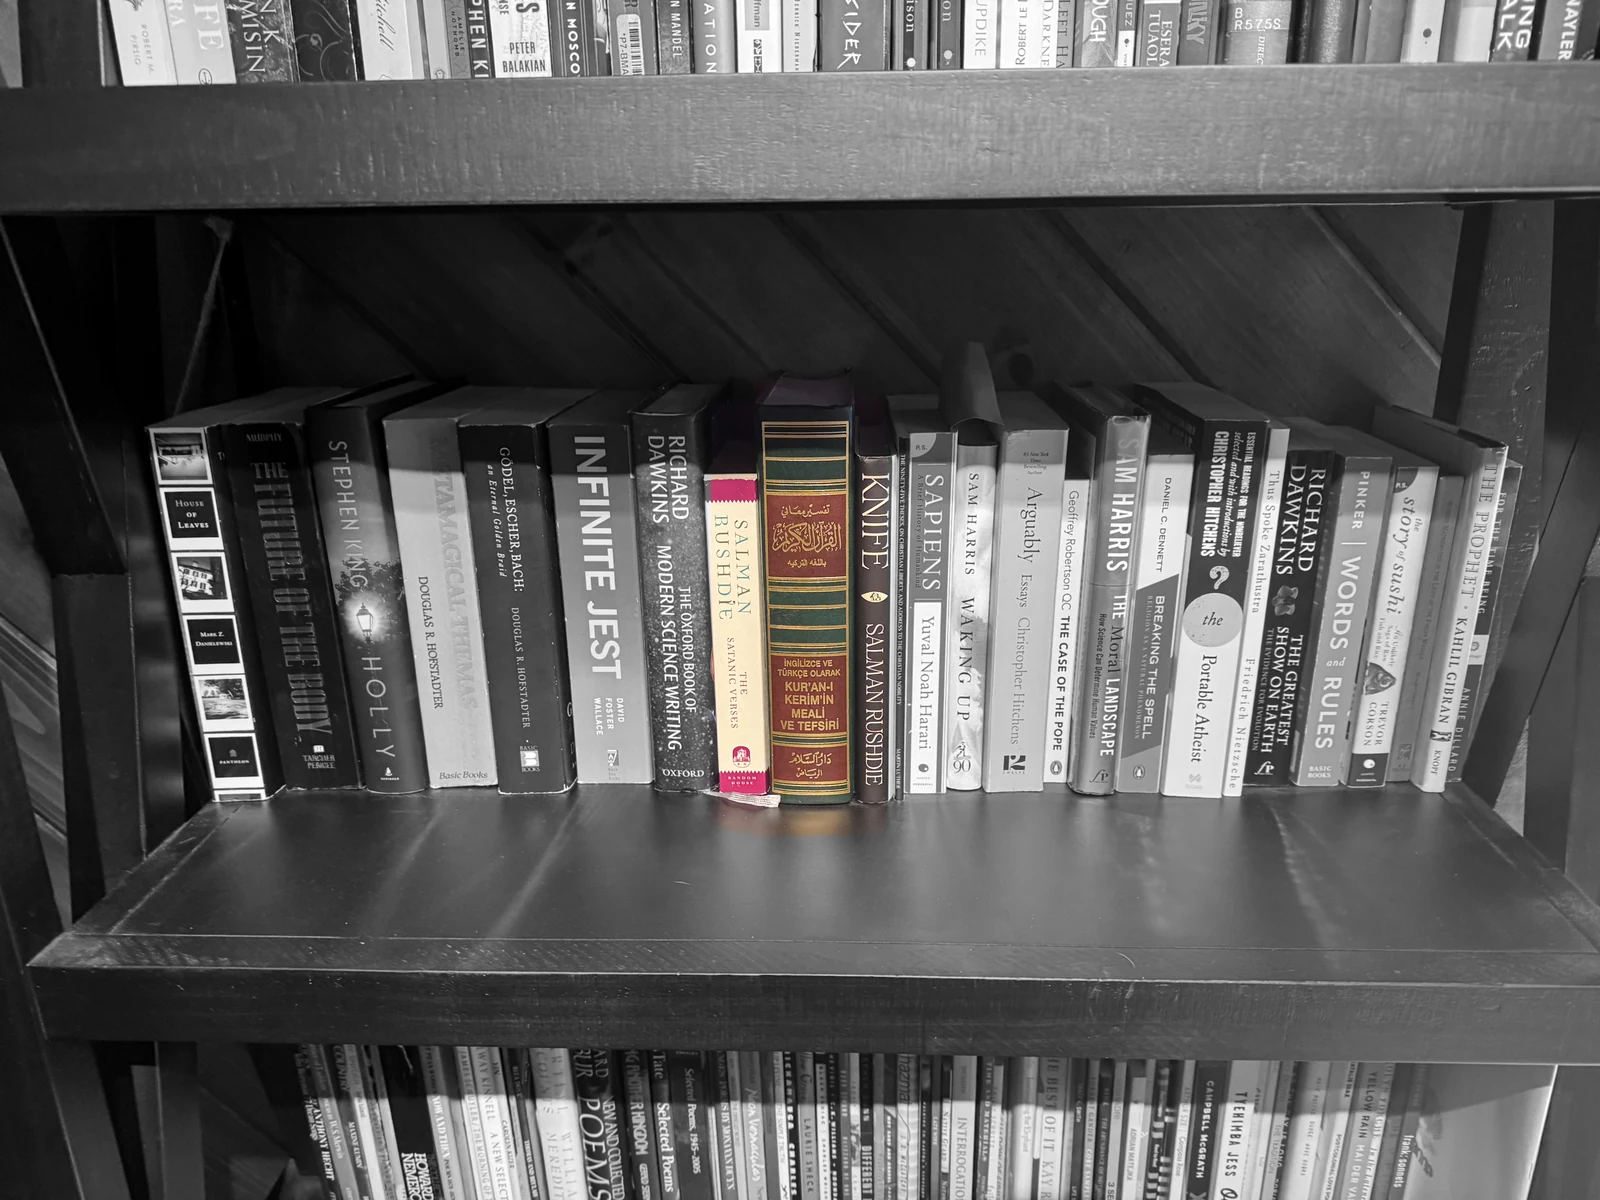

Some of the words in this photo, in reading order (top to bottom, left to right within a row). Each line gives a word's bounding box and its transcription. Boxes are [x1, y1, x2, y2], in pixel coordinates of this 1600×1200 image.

[1234, 7, 1243, 18] B
[509, 42, 536, 54] PETER
[671, 13, 682, 58] MANDEL
[1015, 23, 1026, 65] ROBERT
[502, 59, 546, 73] BALAKIAN
[1113, 438, 1139, 483] SAM
[1206, 430, 1230, 503] CHRISTOPHER
[1243, 431, 1257, 463] ESSENTIAL
[647, 435, 670, 524] DAWKINS
[668, 435, 689, 520] RICHARD
[967, 473, 980, 506] SAM
[1160, 477, 1172, 513] DANIEL
[1239, 464, 1252, 494] READINGS
[1266, 471, 1279, 501] Thus
[1352, 470, 1370, 529] PINKER
[1478, 464, 1498, 503] THE
[328, 441, 360, 530] STEPHEN
[344, 540, 369, 588] KING
[574, 435, 616, 590] INFINITE
[861, 472, 890, 570] KNIFE
[1064, 490, 1079, 536] Geoffrey
[1161, 516, 1168, 524] C.
[1221, 497, 1236, 546] introductions
[1238, 496, 1249, 506] FOR
[1259, 504, 1276, 541] Spoke
[1276, 464, 1307, 575] DAWKINS
[1297, 468, 1326, 572] RICHARD
[1391, 497, 1418, 549] story
[177, 521, 209, 530] LEAVES
[253, 483, 306, 581] FUTURE
[922, 474, 944, 590] SAPIENS
[964, 514, 978, 575] HARRIS
[1018, 487, 1043, 563] Arguably
[1106, 493, 1134, 572] HARRIS
[1201, 506, 1221, 557] HITCHENS
[1232, 520, 1246, 557] NONBELIEVER
[496, 552, 507, 578] Braid
[714, 515, 736, 620] RUSHDIE
[733, 520, 752, 614] SALMAN
[1061, 538, 1076, 591] Robertson
[1155, 527, 1167, 573] DENNETT
[1218, 548, 1230, 557] by
[1398, 550, 1408, 561] of
[1460, 512, 1490, 599] PROPHET
[418, 576, 434, 627] DOUGLAS
[656, 545, 675, 618] MODERN
[678, 587, 692, 611] THE
[1018, 574, 1032, 607] Essays
[1060, 593, 1072, 610] QC
[1252, 545, 1271, 614] Zarathustra
[1386, 564, 1406, 614] sushi
[272, 588, 312, 617] OF
[1098, 613, 1107, 627] How
[1112, 593, 1127, 620] THE
[1202, 616, 1224, 626] the
[1329, 556, 1361, 649] WORDS
[279, 623, 320, 667] THE
[425, 631, 435, 640] R.
[511, 607, 524, 652] DOUGLAS
[586, 601, 622, 678] JEST
[681, 612, 695, 660] OXFORD
[919, 616, 935, 656] Yuval
[958, 598, 975, 684] WAKING
[1060, 616, 1071, 638] THE
[1107, 625, 1124, 673] Moral
[1149, 595, 1165, 665] BREAKING
[1272, 626, 1289, 672] SHOW
[1448, 617, 1468, 668] KAHLIL
[516, 656, 525, 665] R.
[660, 621, 679, 682] SCIENCE
[726, 637, 737, 686] SATANIC
[784, 658, 821, 668] İNGİLİZCE
[822, 659, 833, 667] VE
[810, 669, 841, 677] OLARAK
[864, 623, 885, 702] SALMAN
[1012, 617, 1030, 689] Christopher
[1057, 642, 1069, 673] CASE
[1095, 653, 1104, 665] Can
[1288, 635, 1304, 667] THE
[1326, 660, 1346, 668] and
[426, 643, 443, 708] HOFSTADTER
[517, 667, 530, 728] HOFSTADTER
[683, 662, 696, 695] BOOK
[739, 671, 748, 695] THE
[918, 661, 934, 698] Noah
[1056, 676, 1066, 691] OF
[1146, 668, 1159, 694] THE
[1196, 654, 1217, 710] Portable
[1238, 658, 1255, 721] Friedrich
[1267, 676, 1282, 698] ON
[361, 657, 396, 758] HOLLY
[594, 697, 605, 735] WALLACE
[605, 697, 615, 730] FOSTER
[616, 697, 625, 723] DAVID
[664, 685, 682, 750] WRITING
[685, 697, 697, 713] OF
[729, 688, 740, 729] VERSES
[791, 705, 825, 719] MEALİ
[956, 695, 970, 721] UP
[1010, 693, 1025, 745] Hitchens
[1055, 696, 1066, 718] THE
[1091, 699, 1100, 718] Human
[1100, 678, 1120, 757] LANDSCAPE
[1142, 698, 1156, 739] SPELL
[1276, 671, 1297, 745] GREATEST
[1315, 676, 1342, 749] RULES
[1438, 672, 1458, 724] GIBRAN
[780, 721, 794, 731] VE
[797, 718, 839, 731] TEFSİRİ
[918, 704, 932, 749] Harari
[1053, 722, 1064, 750] POPE
[1089, 720, 1098, 739] Values
[1190, 714, 1211, 763] Atheist
[1260, 704, 1279, 753] EARTH
[1363, 702, 1377, 747] CORSON
[1374, 701, 1391, 747] TREVOR
[864, 708, 884, 787] RUSHDIE
[1228, 727, 1247, 789] Nietzsche
[1448, 727, 1463, 772] DILLARD
[439, 771, 464, 780] Basic
[465, 771, 488, 779] Books
[662, 769, 705, 778] OXFORD
[602, 1096, 616, 1120] NEW
[1201, 1080, 1215, 1131] CAMPBELL
[1363, 1071, 1378, 1111] YELLOW
[604, 1122, 619, 1147] AND
[631, 1111, 648, 1155] KINGDOM
[657, 1103, 673, 1152] Selected
[803, 1118, 813, 1156] LAURIE
[1044, 1115, 1057, 1133] OF
[1128, 1128, 1138, 1151] ADRIAN
[1229, 1092, 1248, 1146] TYEHIMBA
[1358, 1116, 1370, 1138] RAIN
[313, 1108, 329, 1149] ANTHONY
[321, 1151, 335, 1181] HECHT
[438, 1135, 451, 1160] THEN
[578, 1096, 612, 1200] POEMS
[748, 1118, 765, 1182] Vernacular
[1126, 1152, 1136, 1181] MATEJKA
[1196, 1134, 1208, 1179] McGRATH
[1224, 1152, 1239, 1177] JESS
[414, 1153, 434, 1200] HOWARD
[662, 1155, 675, 1192] Poems
[789, 1143, 797, 1195] CHARLES
[806, 1161, 815, 1194] SHECK
[861, 1145, 872, 1194] DIFFERENT
[1041, 1161, 1054, 1187] KAY
[1394, 1159, 1408, 1188] sonnets
